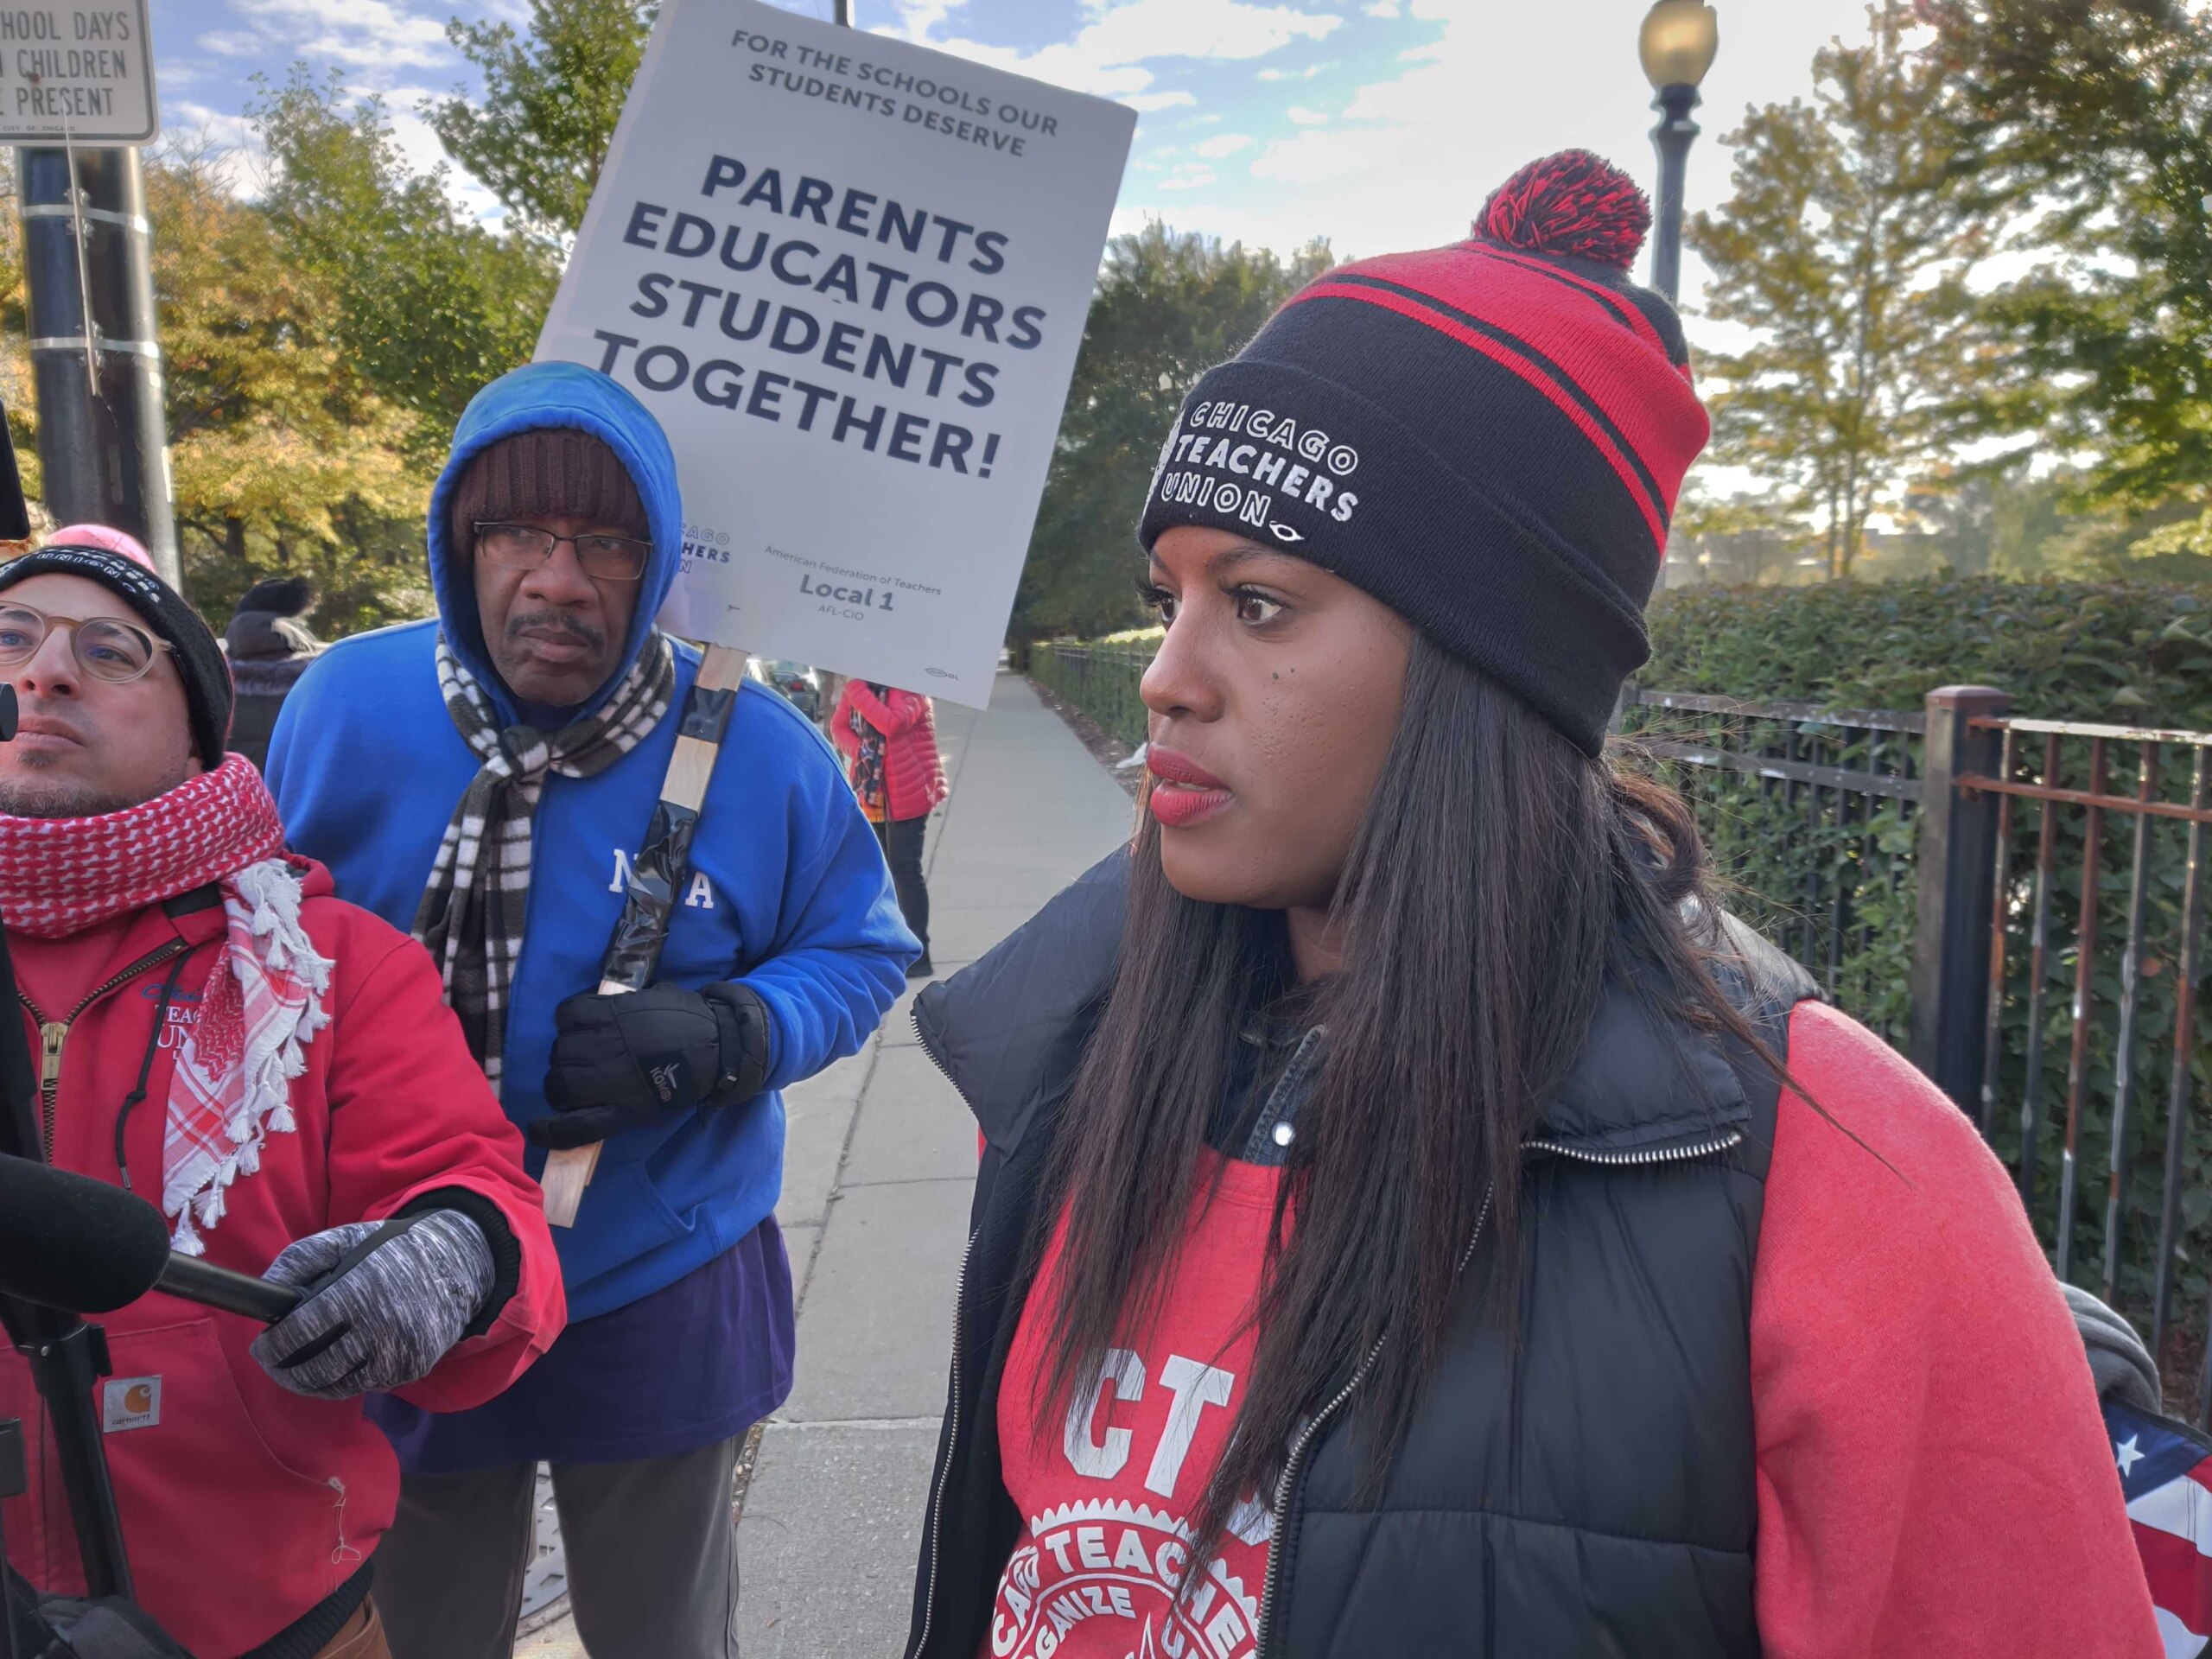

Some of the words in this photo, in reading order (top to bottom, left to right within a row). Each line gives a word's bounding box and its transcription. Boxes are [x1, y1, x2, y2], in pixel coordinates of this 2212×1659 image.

[73, 11, 130, 41] DAYS
[16, 49, 127, 79] CHILDREN
[731, 29, 788, 60] FOR
[798, 46, 851, 75] THE
[856, 63, 991, 116] SCHOOLS
[998, 105, 1058, 137] OUR
[16, 87, 113, 116] PRESENT
[748, 64, 895, 117] STUDENTS
[903, 104, 1026, 156] DESERVE
[701, 154, 1009, 276] PARENTS
[623, 200, 1047, 350] EDUCATORS
[629, 272, 1001, 408] STUDENTS
[594, 329, 1001, 479] TOGETHER!
[1190, 402, 1358, 475] CHICAGO
[1161, 472, 1271, 527] UNION
[1175, 435, 1359, 522] TEACHERS
[765, 545, 817, 569] American
[819, 562, 876, 582] Federation
[880, 576, 892, 585] of
[894, 577, 942, 595] Teachers
[800, 574, 874, 607] Local
[879, 592, 893, 611] 1
[818, 604, 864, 620] AFL-CIO
[609, 849, 714, 909] NA
[1028, 1586, 1137, 1659] GANIZE
[1044, 1526, 1259, 1659] TEACHE
